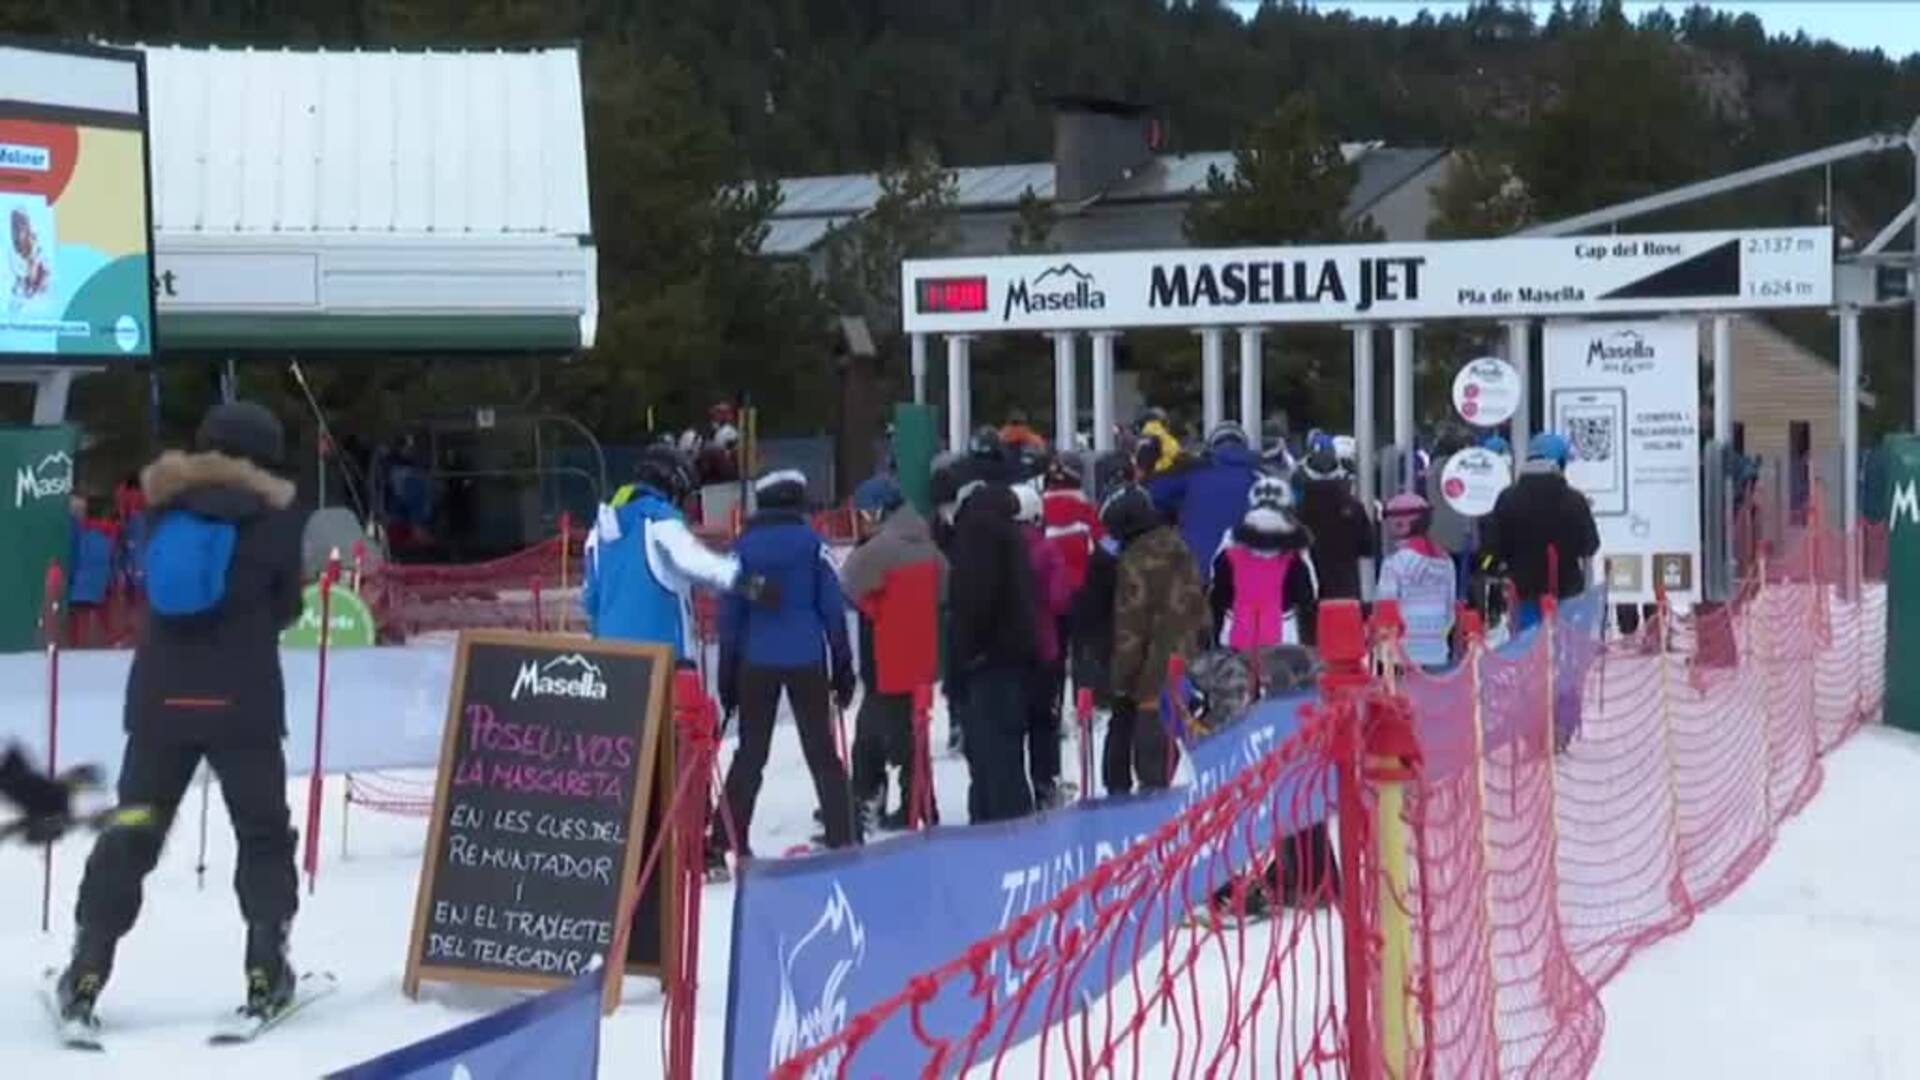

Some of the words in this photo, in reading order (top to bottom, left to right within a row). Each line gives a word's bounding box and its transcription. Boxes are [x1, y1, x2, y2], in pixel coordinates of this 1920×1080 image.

[1574, 243, 1606, 259] Cap
[1612, 242, 1638, 256] del
[1004, 276, 1105, 321] Masella
[1149, 259, 1346, 308] MASELLA
[1355, 256, 1425, 312] JET
[1457, 288, 1486, 304] Pla
[1491, 287, 1512, 303] de
[1518, 286, 1585, 302] Masella
[1586, 337, 1655, 367] Masella
[511, 659, 608, 700] Masella
[455, 758, 484, 788] LA
[491, 763, 624, 802] MASCARETA
[451, 805, 483, 829] EN
[495, 810, 532, 833] LES
[449, 835, 613, 884] REMUNTADOR
[435, 901, 467, 925] EN
[474, 904, 497, 928] EL
[430, 934, 466, 957] DEL
